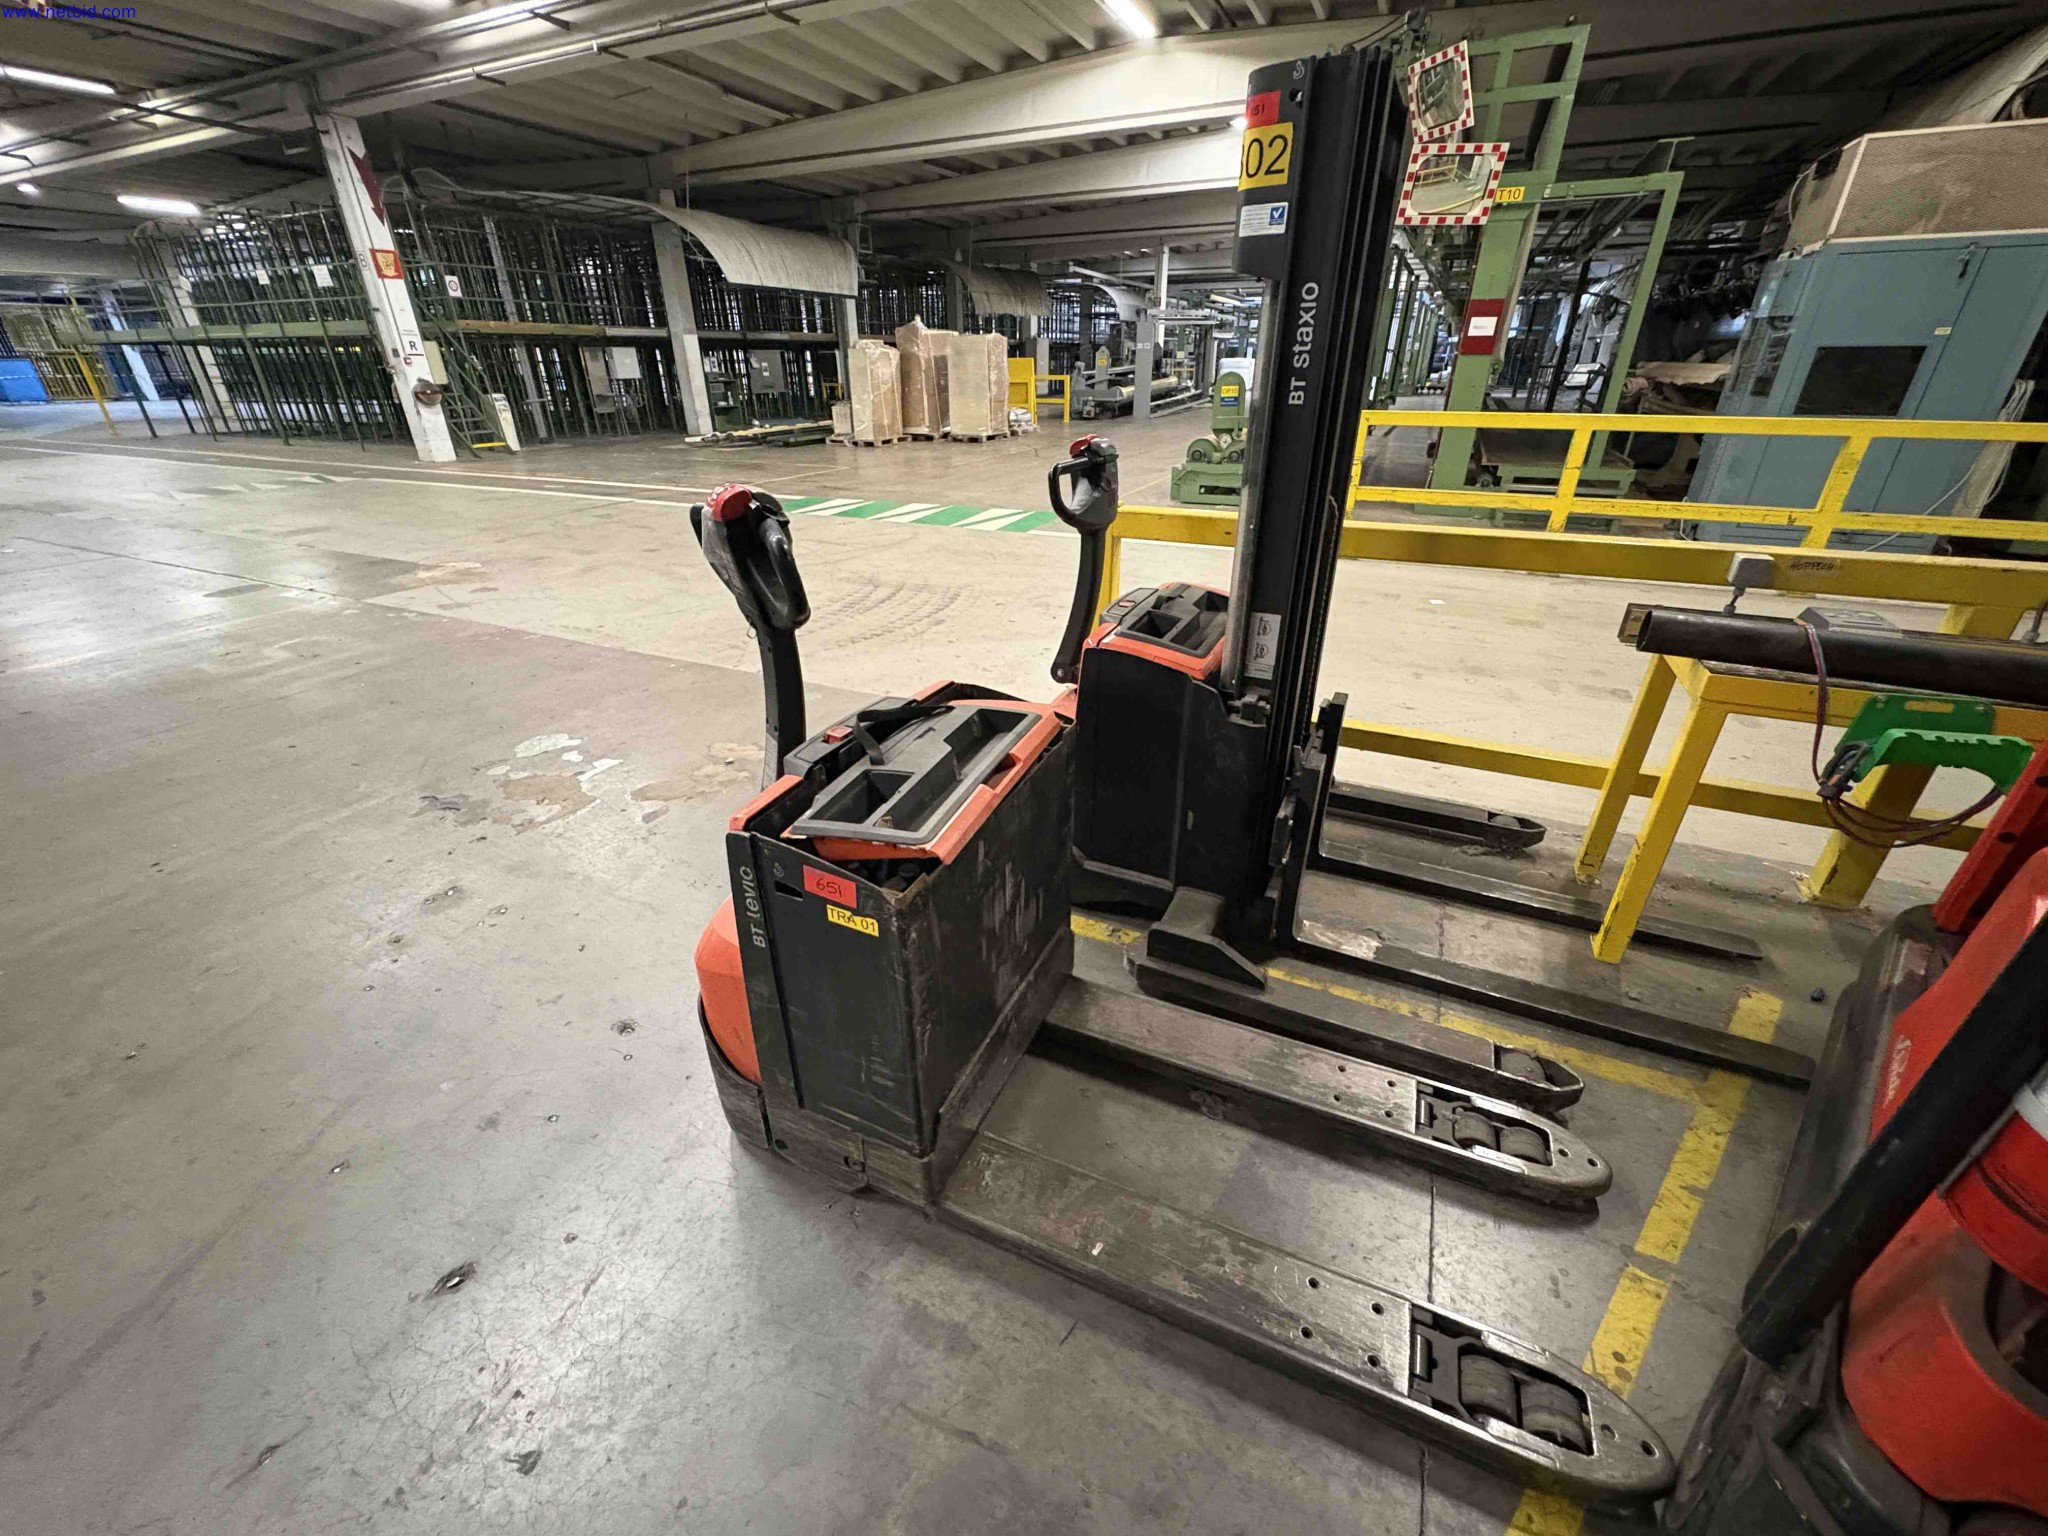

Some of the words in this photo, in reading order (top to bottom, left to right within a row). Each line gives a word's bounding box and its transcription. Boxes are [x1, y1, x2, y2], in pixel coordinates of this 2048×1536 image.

[1240, 134, 1288, 180] 02
[1498, 188, 1521, 201] T10
[409, 340, 418, 351] R
[1288, 377, 1306, 405] BT
[816, 876, 842, 898] 651
[828, 908, 857, 927] TRA
[860, 919, 876, 933] 01
[750, 923, 766, 948] BT
